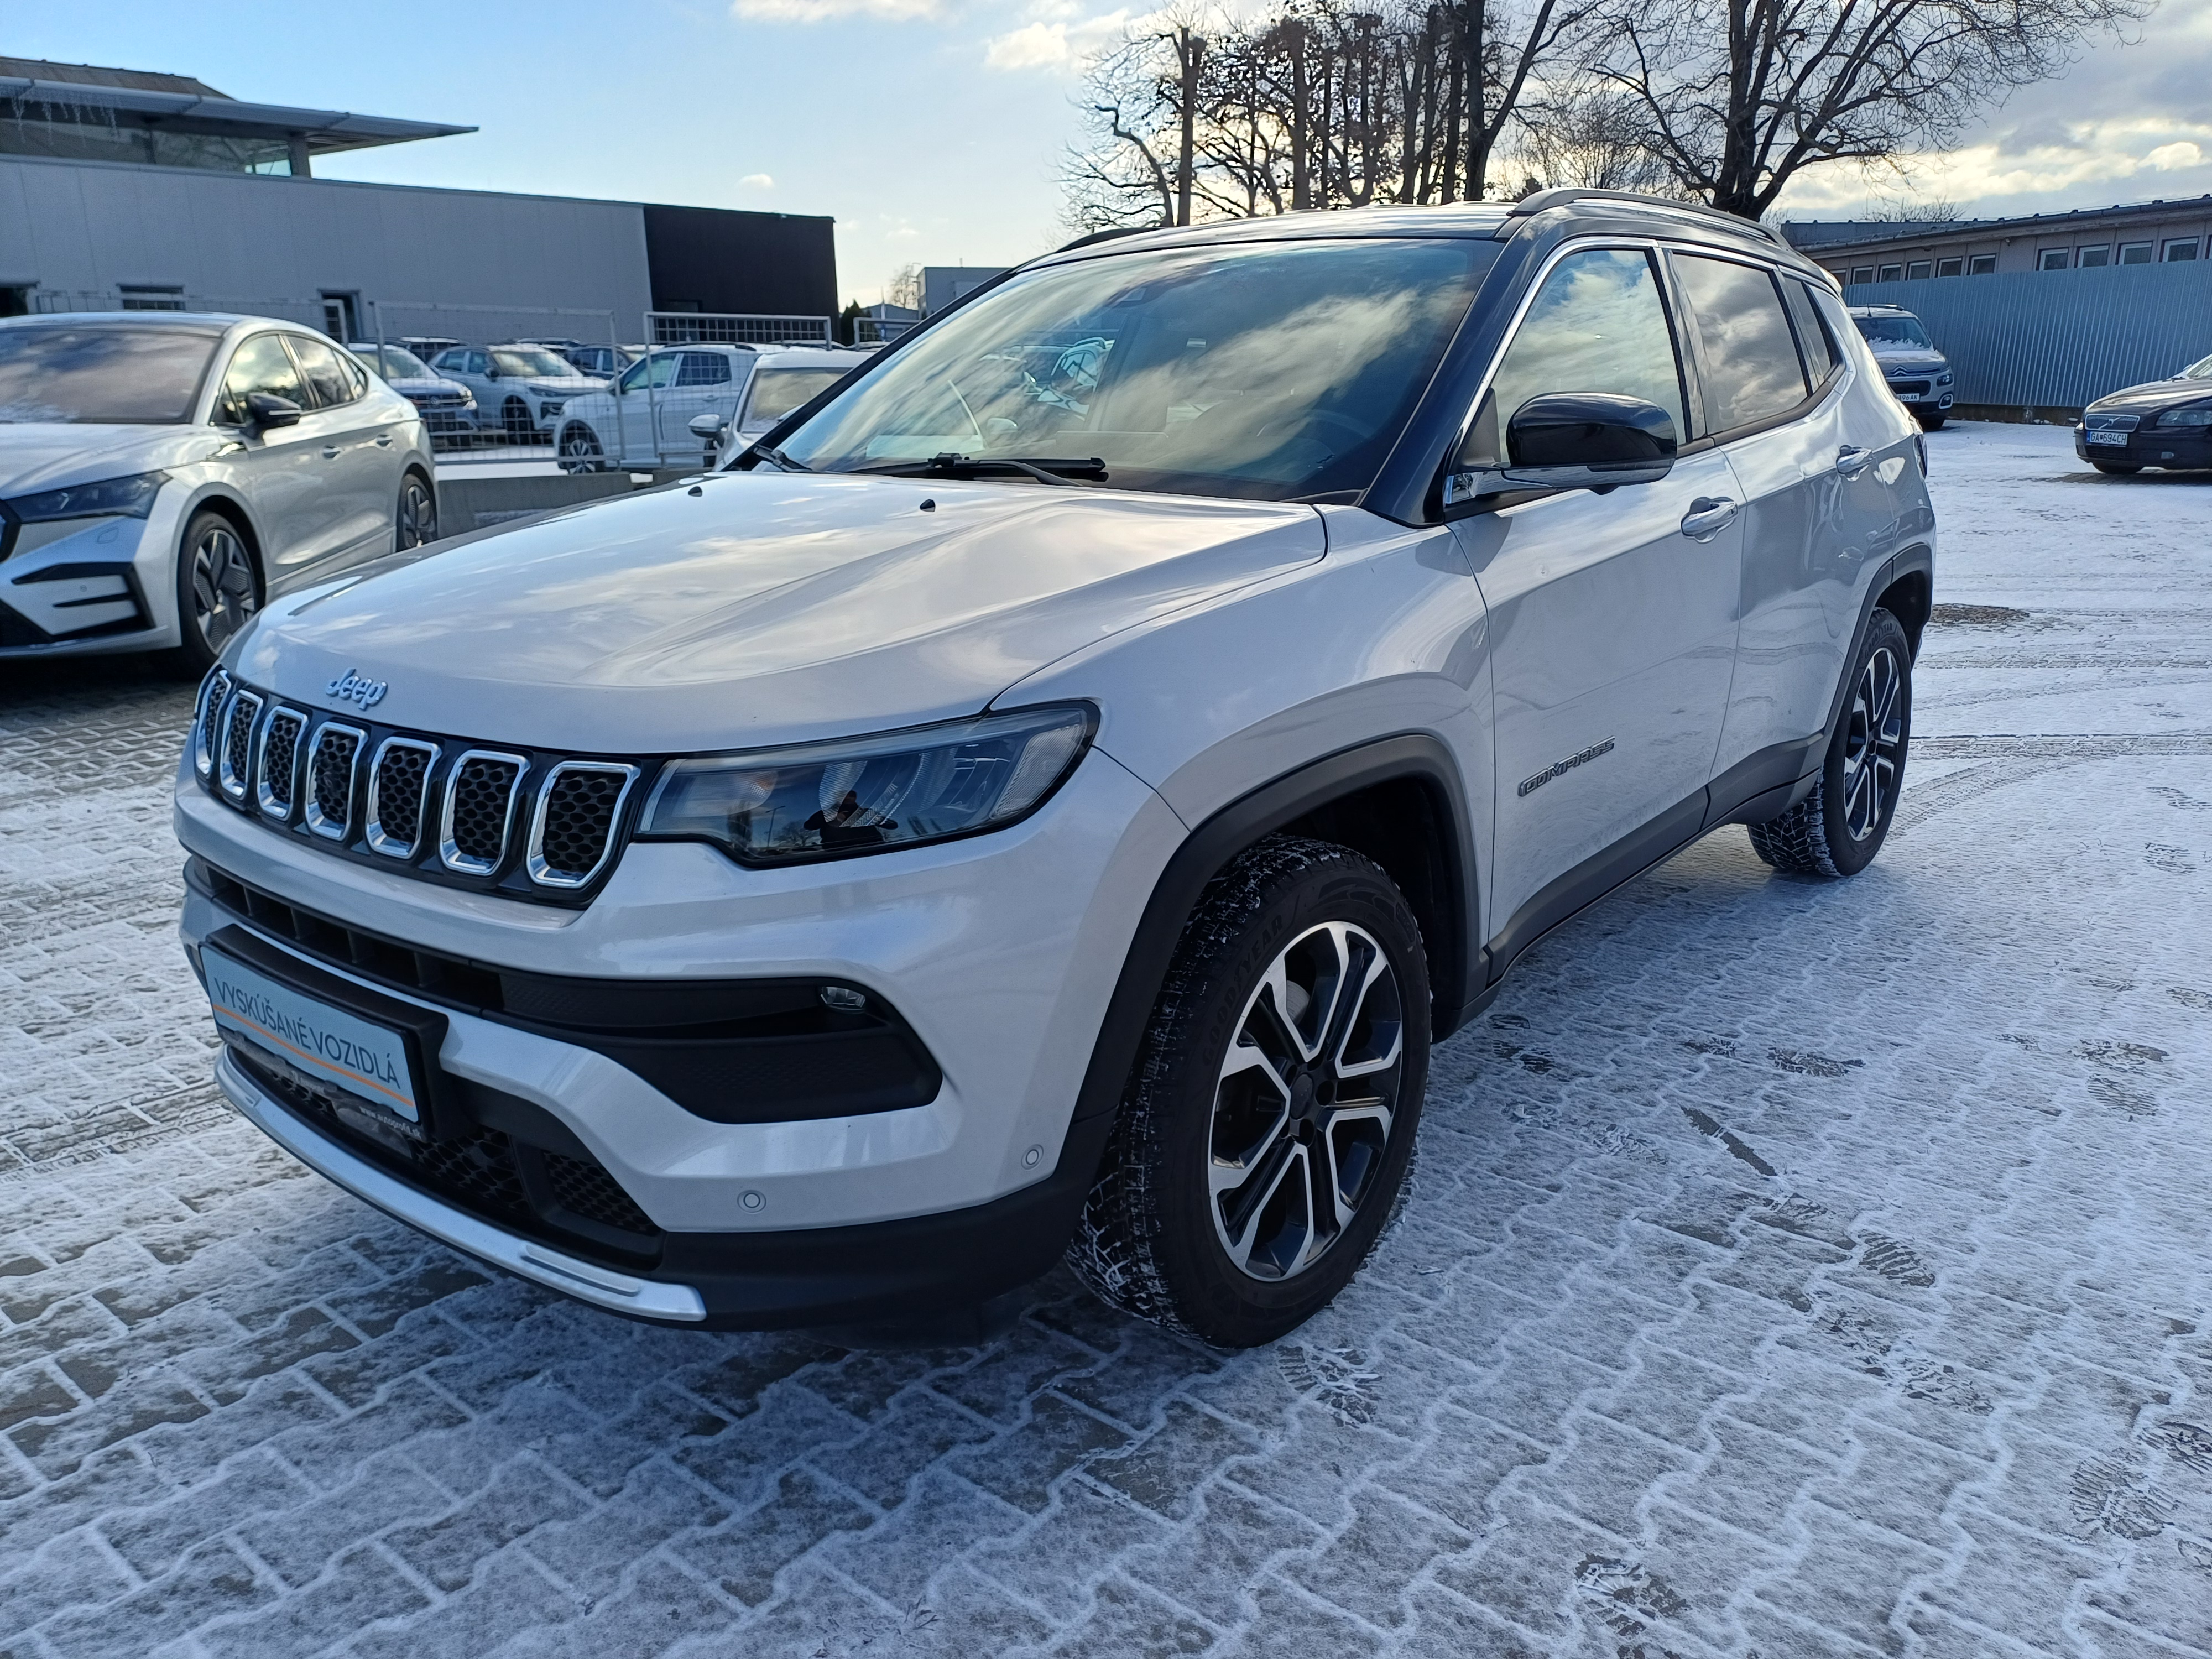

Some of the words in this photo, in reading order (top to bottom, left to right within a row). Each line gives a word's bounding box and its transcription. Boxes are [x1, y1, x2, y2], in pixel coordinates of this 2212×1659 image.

[2103, 433, 2127, 444] 694CH
[326, 667, 388, 711] Jeep
[1517, 735, 1616, 797] COMPASS
[214, 977, 311, 1051] VYSKÚŠANÉ
[309, 1026, 401, 1089] VOZIDLÁ
